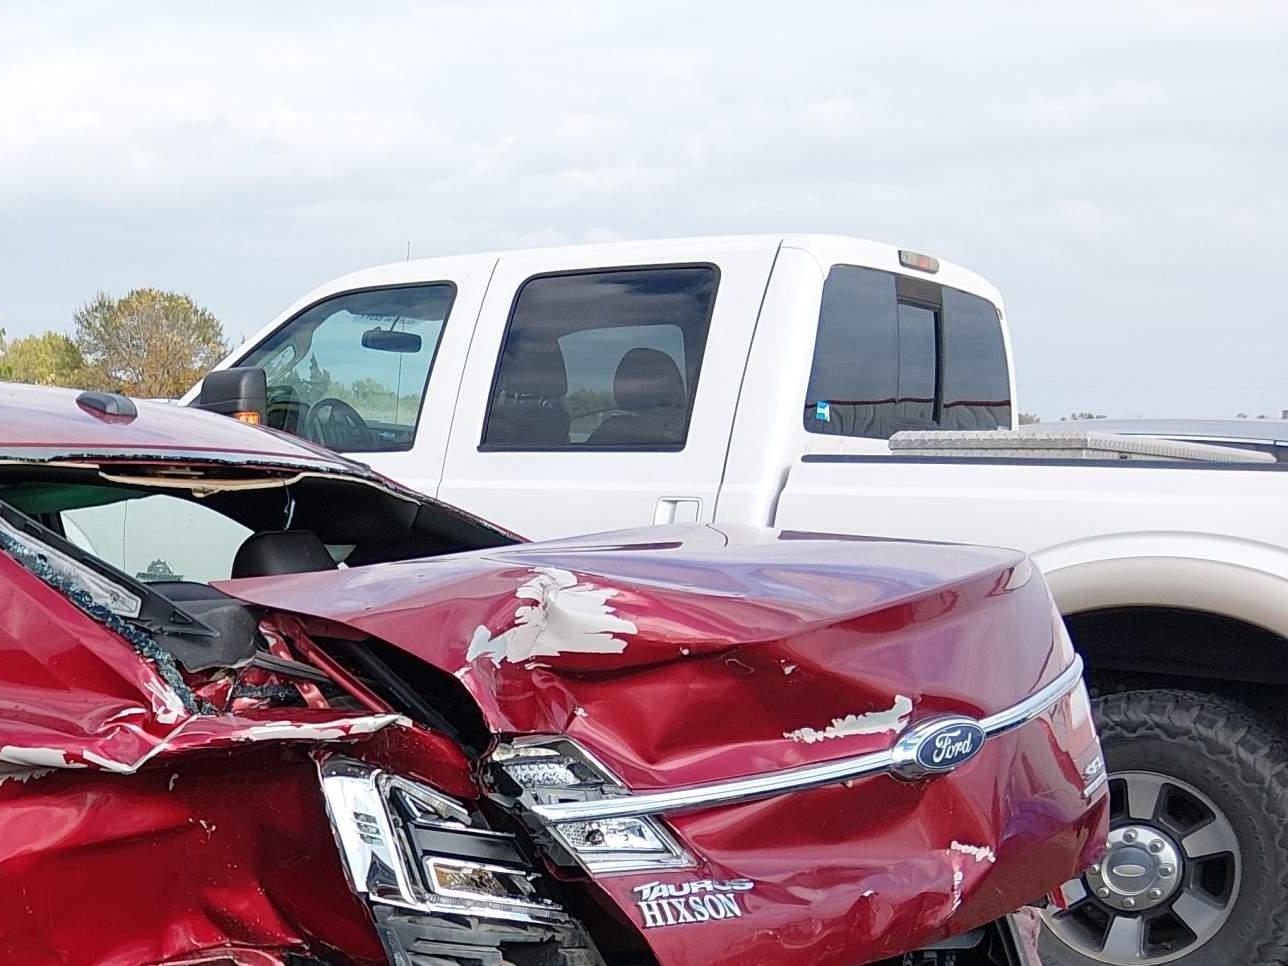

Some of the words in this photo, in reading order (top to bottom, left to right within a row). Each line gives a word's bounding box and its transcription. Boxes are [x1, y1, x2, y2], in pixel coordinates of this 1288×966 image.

[932, 729, 973, 763] Ford
[633, 879, 754, 901] TAURUS
[638, 893, 744, 928] HIXSON
